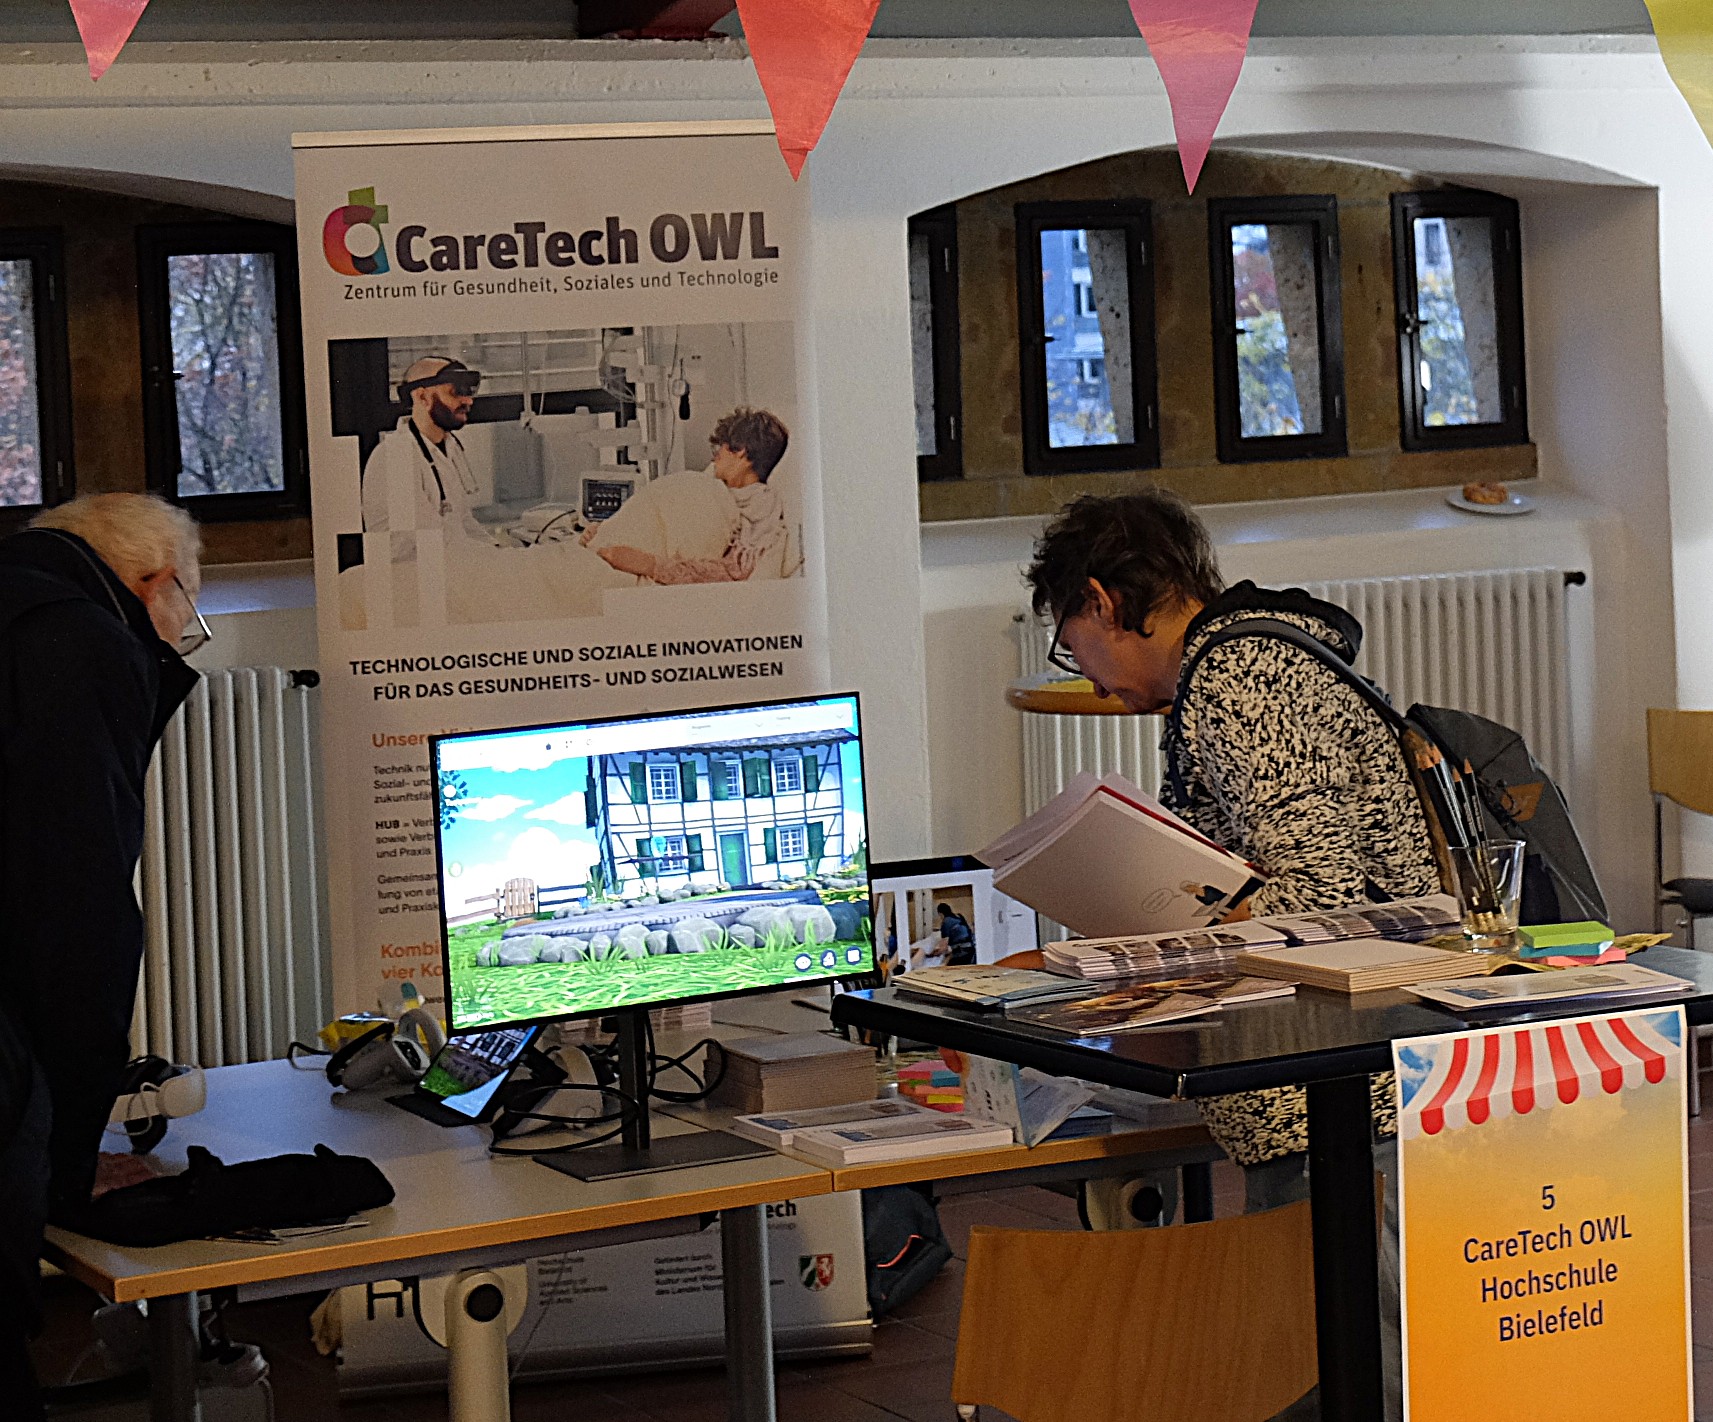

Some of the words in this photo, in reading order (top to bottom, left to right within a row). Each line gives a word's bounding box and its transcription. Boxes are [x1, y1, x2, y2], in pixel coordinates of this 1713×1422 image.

[396, 216, 639, 272] CareTech
[650, 211, 779, 263] OWL
[344, 283, 417, 300] Zentrum
[423, 279, 446, 296] für
[453, 276, 558, 297] Gesundheit,
[564, 274, 635, 292] Soziales
[640, 271, 672, 288] und
[677, 268, 779, 287] Technologie
[349, 651, 529, 676] TECHNOLOGISCHE
[532, 648, 574, 665] UND
[578, 643, 658, 662] SOZIALE
[662, 635, 804, 657] INNOVATIONEN
[373, 682, 411, 701] FÜR
[415, 681, 455, 698] DAS
[458, 674, 600, 696] GESUNDHEITS-
[605, 669, 647, 686] UND
[651, 661, 784, 684] SOZIALWESEN
[375, 819, 400, 830] HUB
[377, 848, 398, 859] und
[400, 846, 432, 857] Praxis
[378, 904, 399, 915] und
[381, 965, 416, 979] vier
[1541, 1185, 1556, 1210] 5
[1464, 1224, 1572, 1263] CareTech
[1580, 1215, 1632, 1244] OWL
[1481, 1258, 1619, 1303] Hochschule
[1499, 1299, 1604, 1342] Bielefeld
